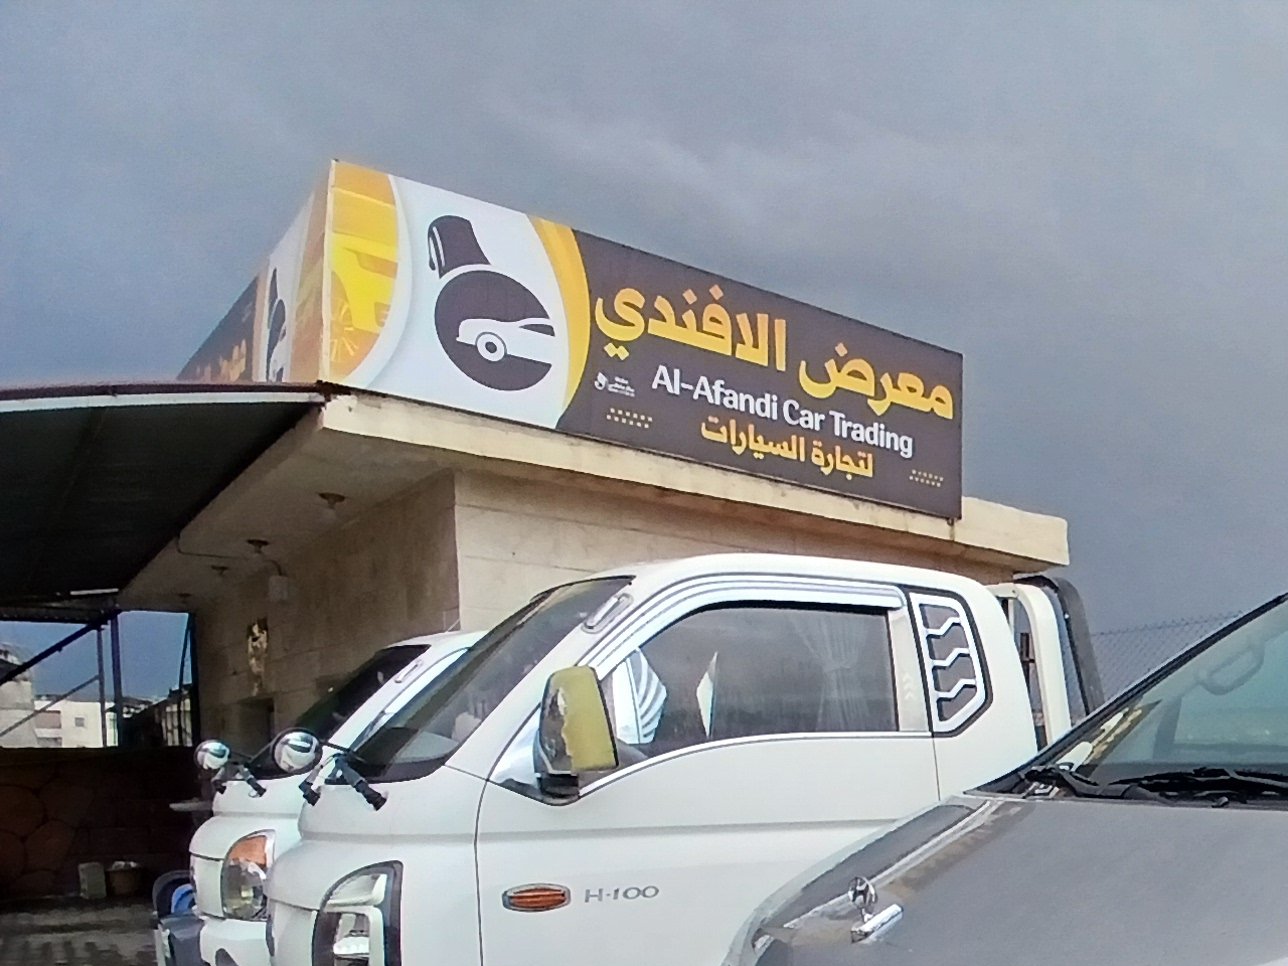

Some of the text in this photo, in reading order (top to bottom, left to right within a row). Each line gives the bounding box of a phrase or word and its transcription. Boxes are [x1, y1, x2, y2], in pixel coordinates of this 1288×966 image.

[595, 284, 954, 420] معرض الافندي
[651, 364, 778, 420] Al-Afandi
[782, 399, 826, 432] Car
[828, 410, 913, 459] Trading
[701, 415, 874, 481] لتجارة السيارات
